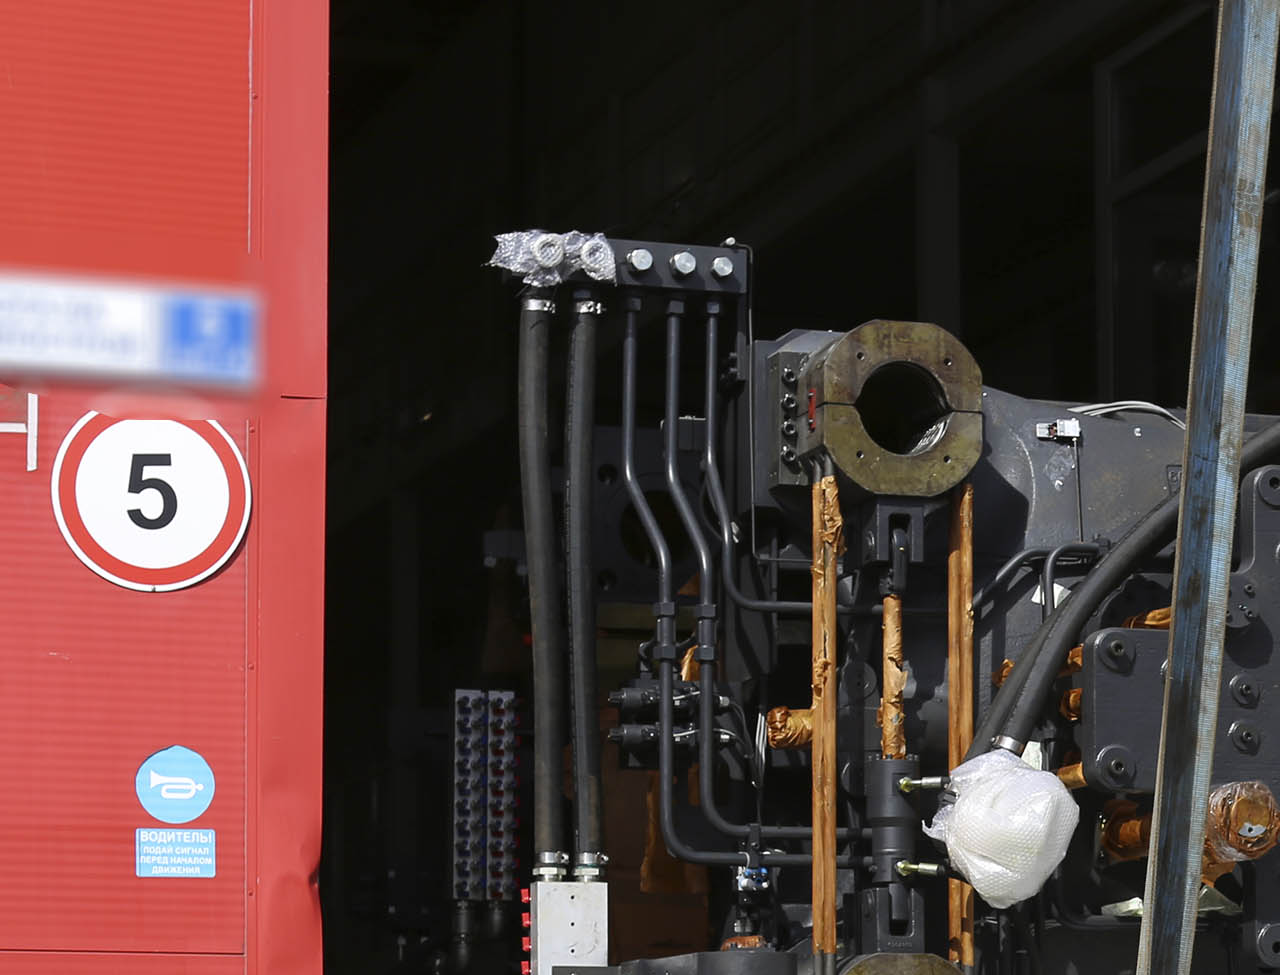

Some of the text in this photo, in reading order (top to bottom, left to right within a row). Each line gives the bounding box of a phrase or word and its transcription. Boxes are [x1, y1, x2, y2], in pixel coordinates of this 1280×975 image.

[127, 454, 178, 530] 5
[144, 846, 173, 855] ПОДАЙ
[140, 856, 212, 864] ПЕРЕД НАЧАЛОМ
